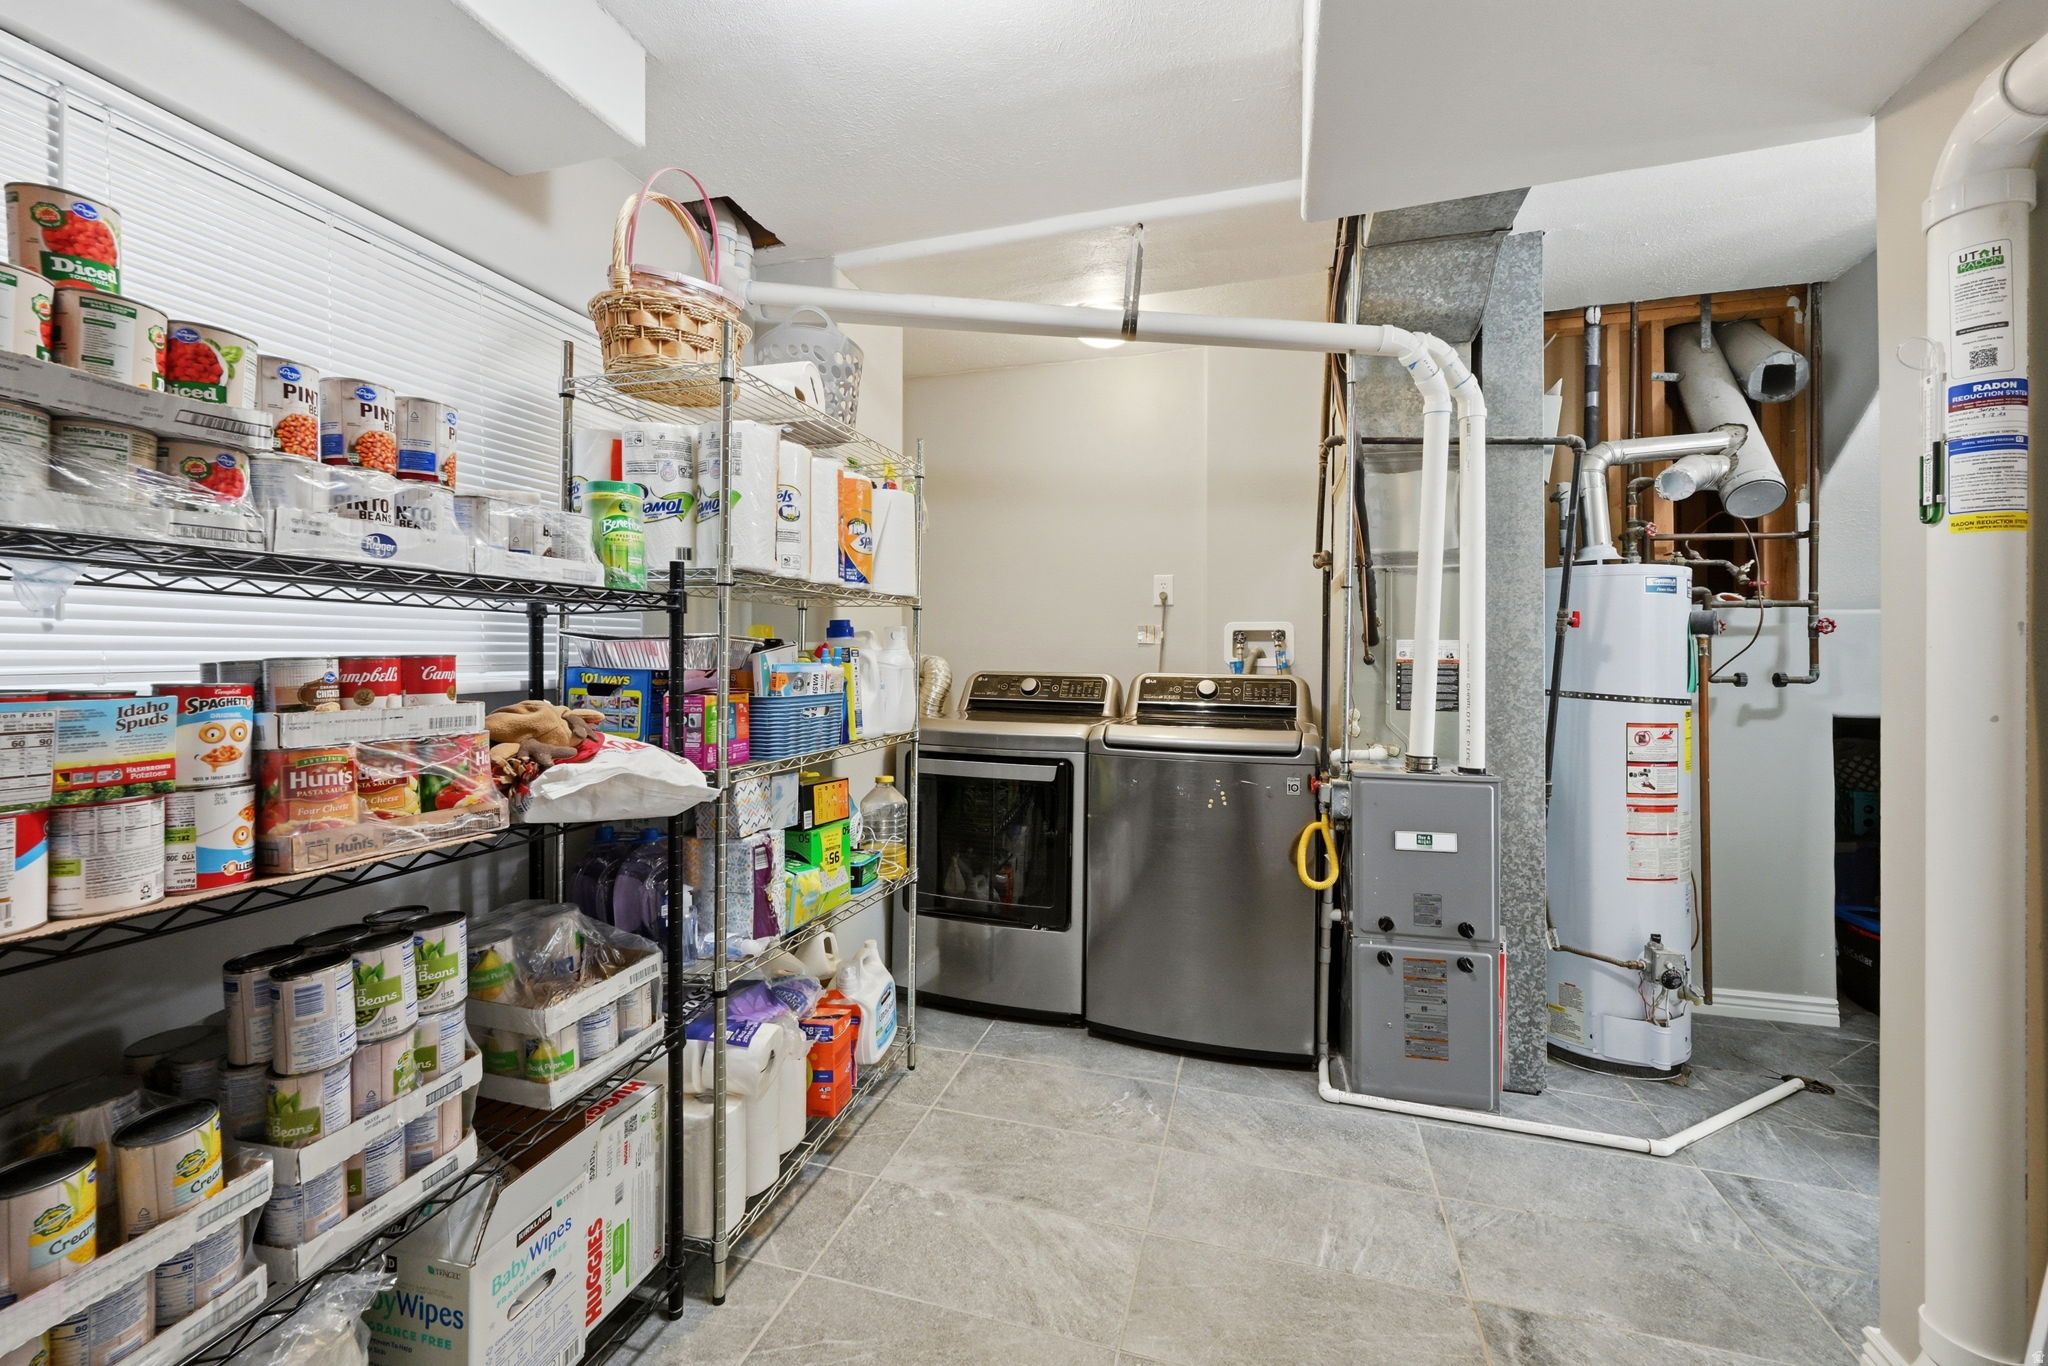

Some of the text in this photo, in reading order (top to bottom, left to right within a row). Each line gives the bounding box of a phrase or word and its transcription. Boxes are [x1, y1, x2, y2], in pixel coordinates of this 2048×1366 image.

[50, 256, 118, 285] Diced
[1972, 381, 2018, 393] RADON
[1952, 390, 2004, 403] REDUCTION
[358, 510, 392, 524] BEANS
[340, 666, 398, 686] ampbell's
[580, 672, 631, 686] 101 WAYS
[21, 711, 53, 719] Facts
[116, 701, 170, 720] Idaho
[115, 712, 170, 734] Spuds
[11, 738, 53, 748] 60 90
[296, 789, 324, 798] PASTA
[297, 807, 321, 817] Four
[419, 967, 456, 982] Beans
[357, 991, 400, 1008] Beans
[272, 1123, 314, 1138] Beans
[528, 1217, 573, 1262] Wipes
[584, 1217, 603, 1328] HUGGIES
[396, 1289, 464, 1330] Wipes
[421, 1333, 453, 1351] FREE
